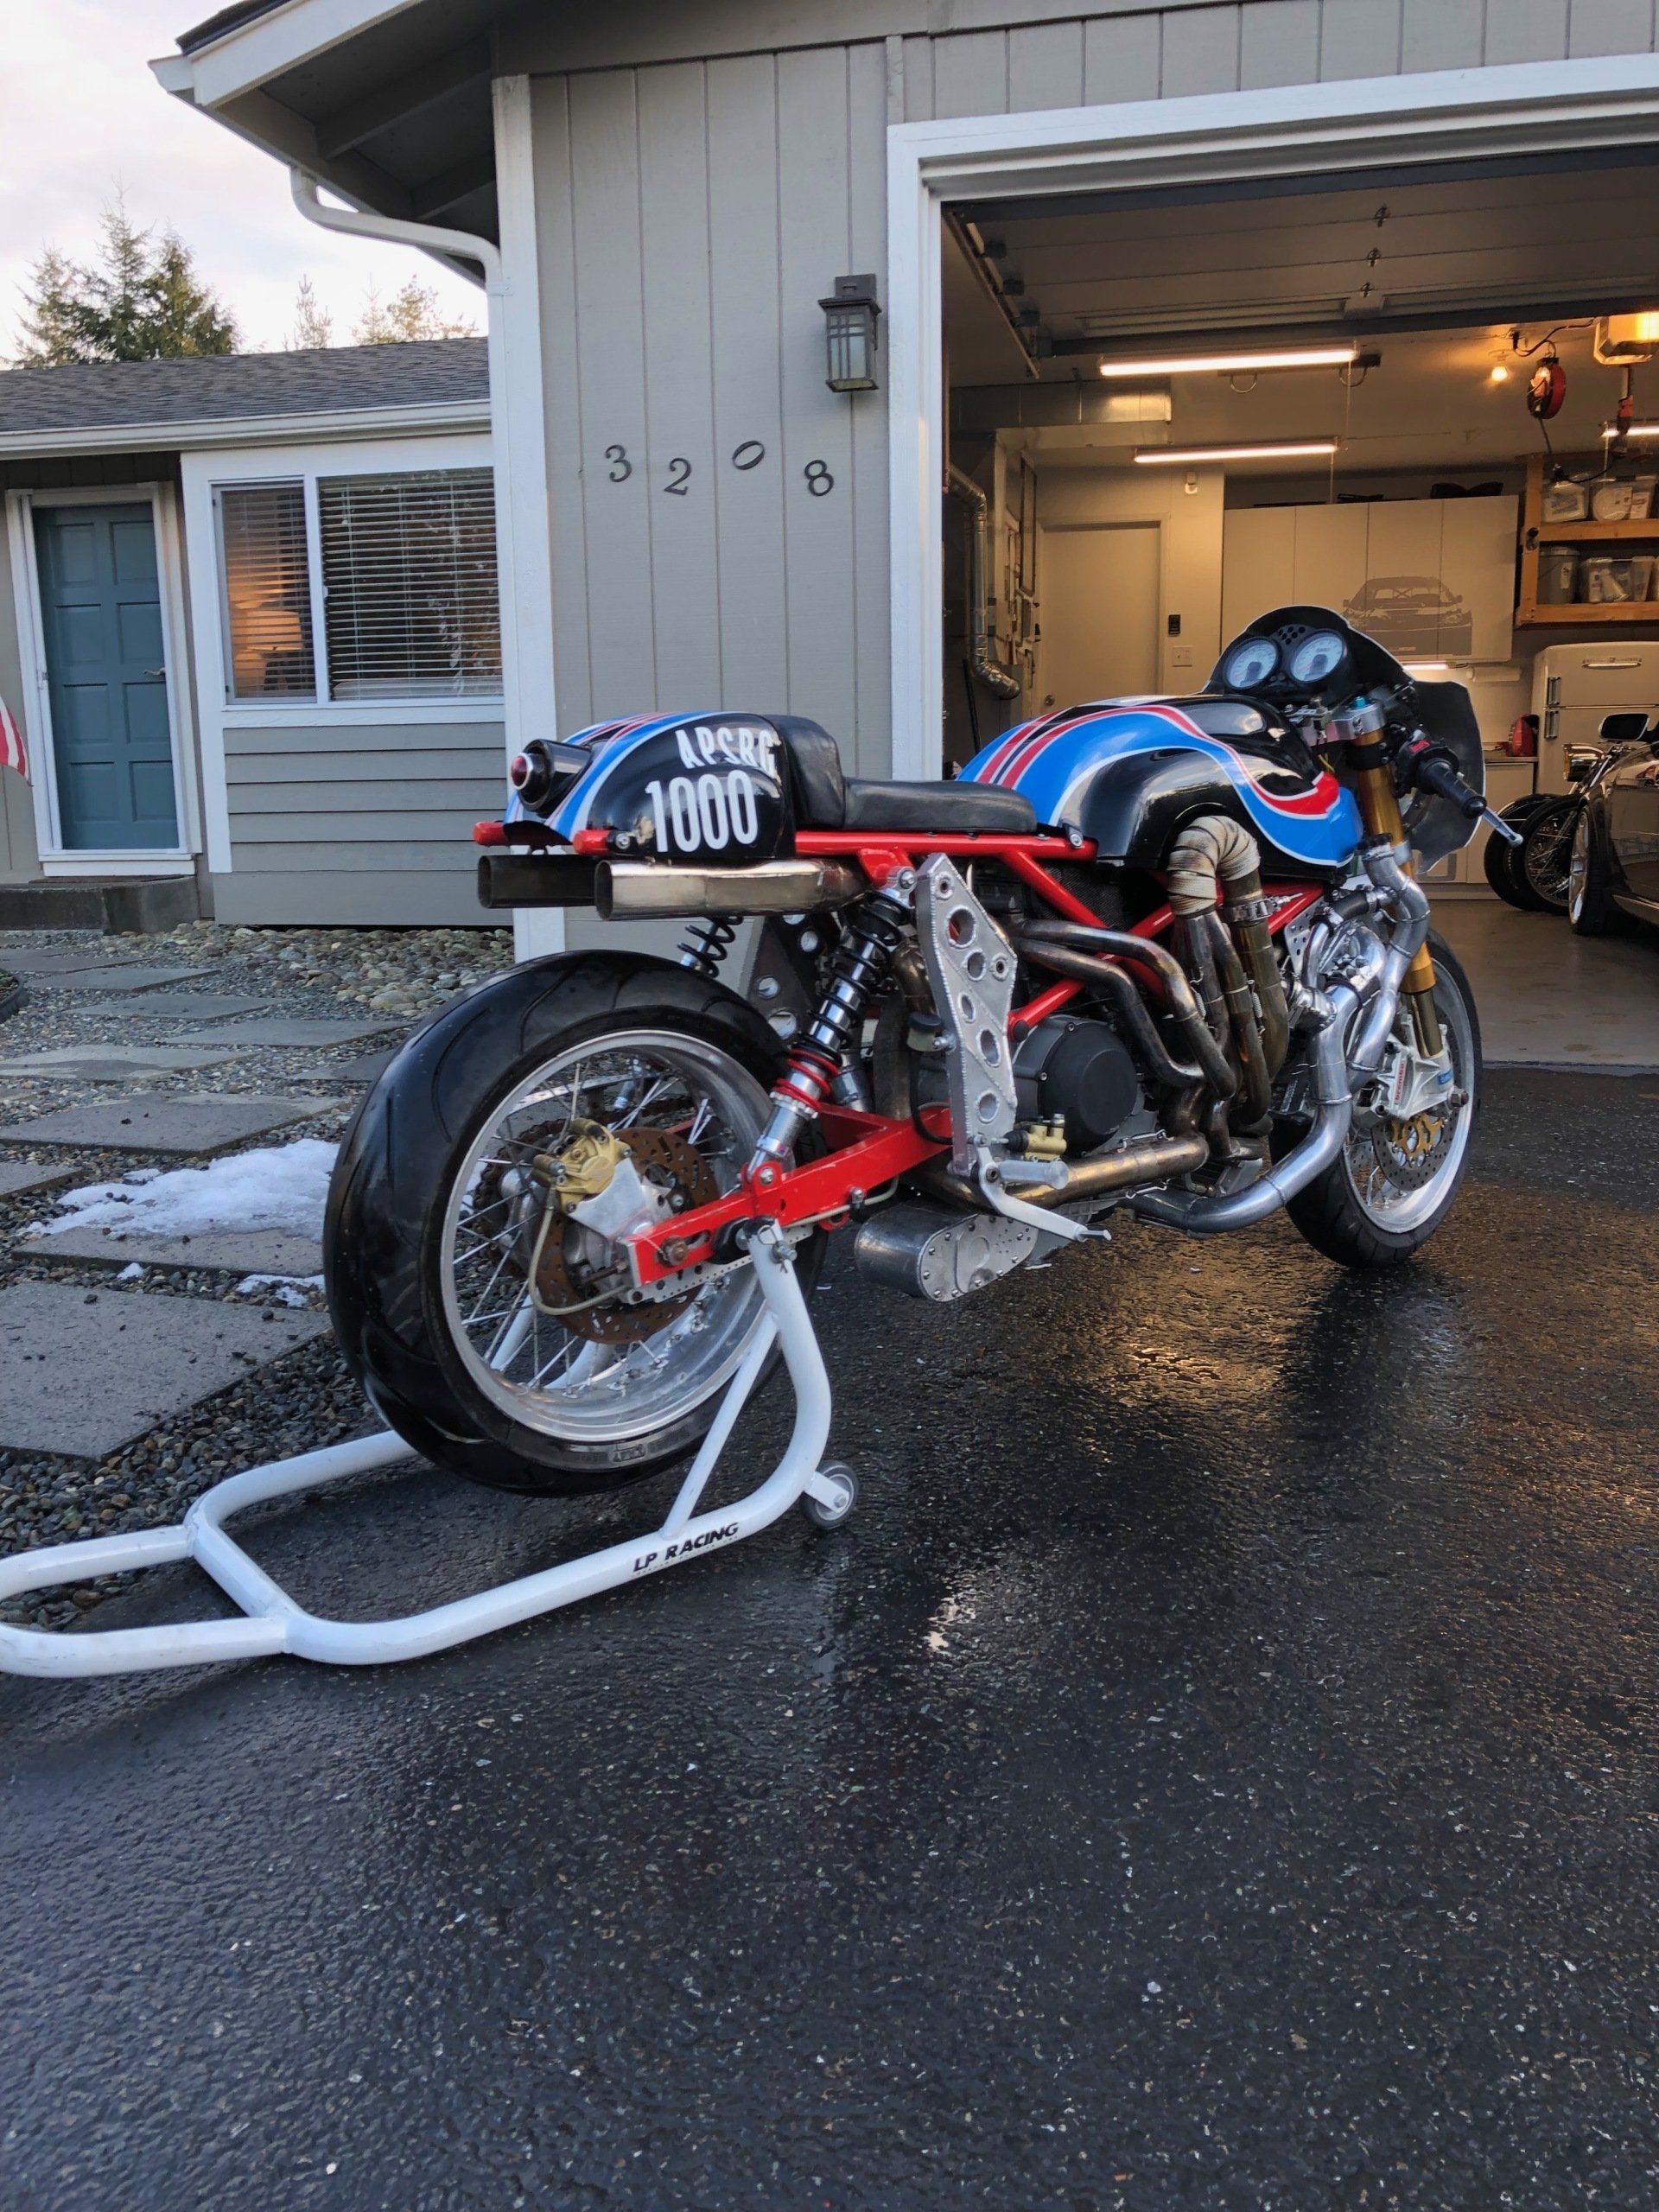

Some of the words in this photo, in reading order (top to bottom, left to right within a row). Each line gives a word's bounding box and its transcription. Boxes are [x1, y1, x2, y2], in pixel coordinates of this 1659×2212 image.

[605, 441, 836, 497] 3208
[645, 770, 759, 853] 1000
[633, 1552, 658, 1573] LP
[664, 1522, 740, 1561] RACING
